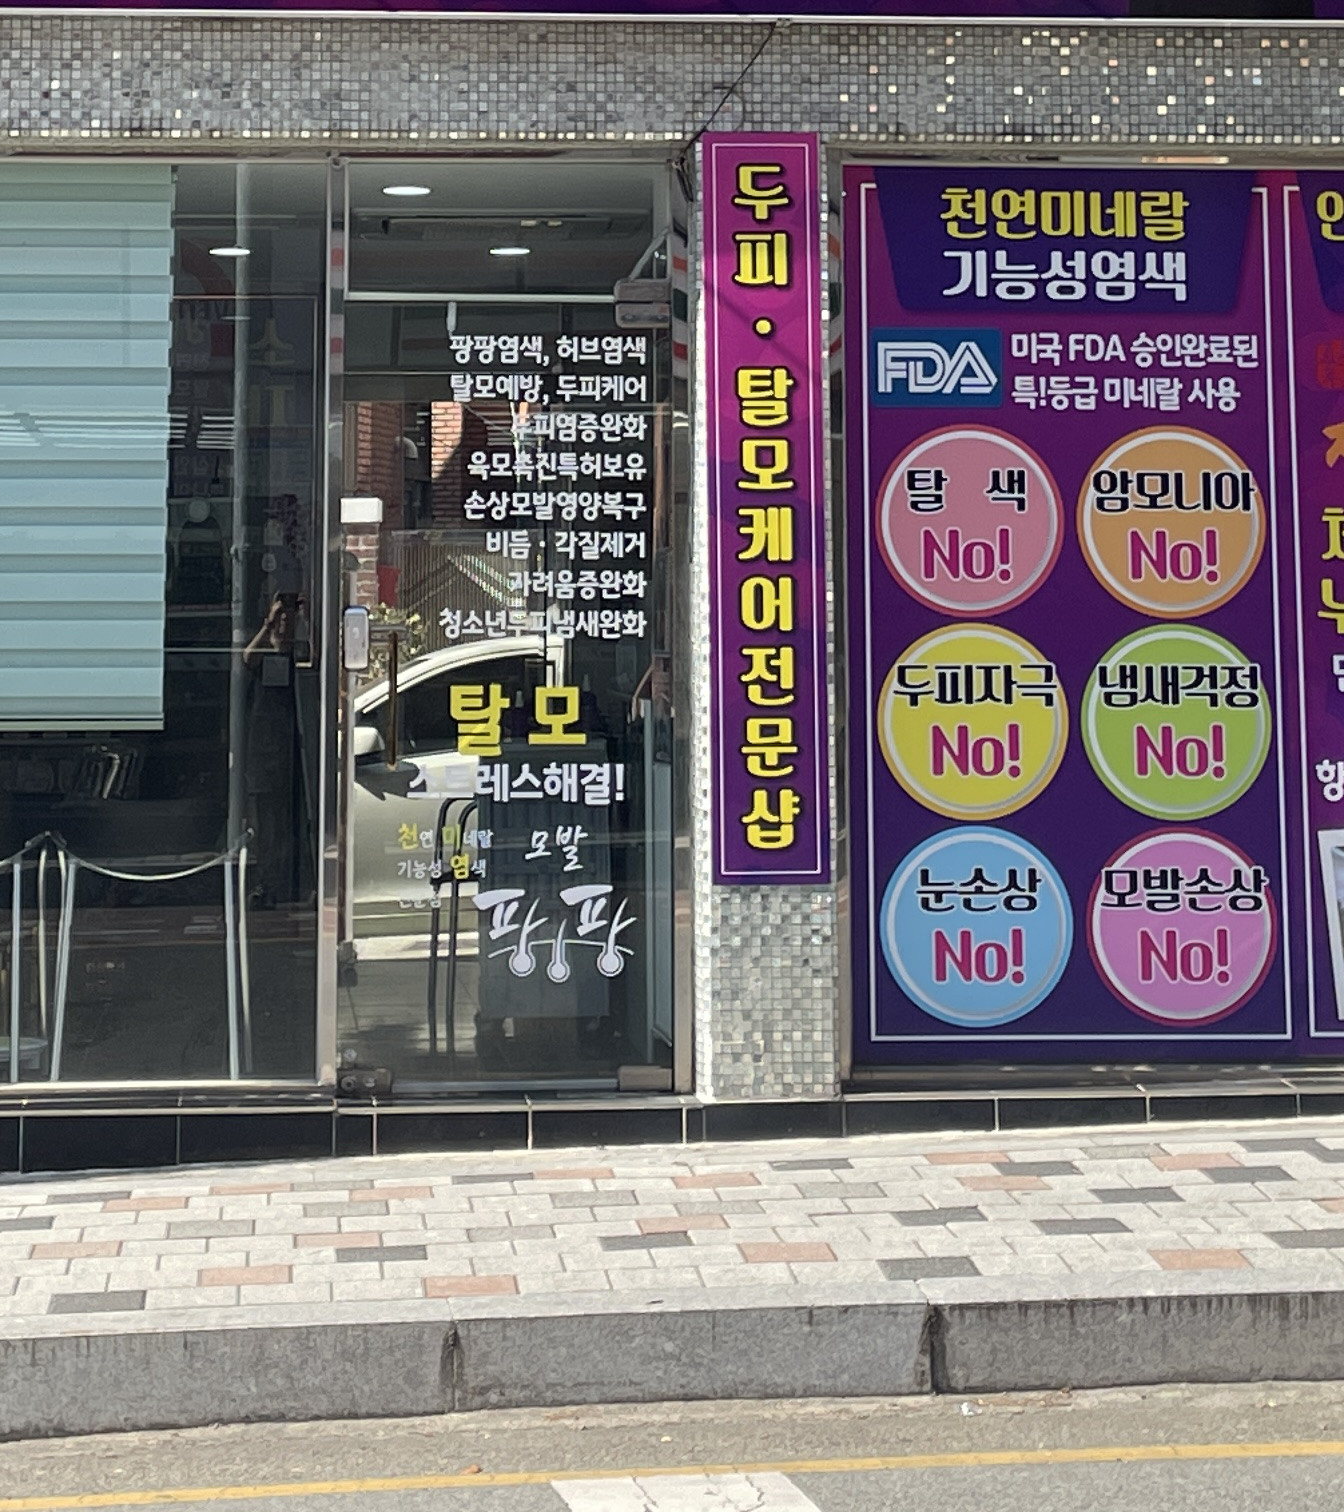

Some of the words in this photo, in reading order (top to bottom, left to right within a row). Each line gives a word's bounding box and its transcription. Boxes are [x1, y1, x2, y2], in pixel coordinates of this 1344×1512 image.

[940, 187, 1190, 242] 천연미네랄
[941, 249, 1188, 302] 기능성염색
[449, 335, 551, 366] 팡팡염색,
[556, 335, 647, 365] 허브염색
[877, 341, 998, 394] FDA
[1011, 334, 1062, 365] 미국
[1069, 335, 1126, 363] FDA
[1130, 332, 1259, 367] 승인완료된
[449, 374, 550, 404] 탈모예방,
[556, 375, 647, 402] 두피케어
[1103, 378, 1182, 411] 미네랄
[1188, 378, 1241, 411] 사용
[511, 413, 647, 443] 두피염증완화
[467, 451, 647, 481] 육모촉진특허보유
[463, 490, 647, 521] 손상모발영양복구
[1093, 470, 1256, 513] 암모니아
[485, 530, 531, 560] 비듬
[554, 531, 646, 560] 각질제거
[921, 528, 1012, 582] No!
[1127, 529, 1219, 584] No!
[508, 570, 647, 600] 가려움증완화
[439, 608, 647, 639] 청소년두피냄새완화
[893, 664, 1058, 707] 두피자극
[1097, 665, 1260, 709] 냄새걱정
[931, 724, 1022, 778] No!
[1135, 725, 1226, 779] No!
[397, 859, 443, 880] 기능성
[450, 853, 487, 880] 염색
[916, 867, 1042, 912] 눈손상
[1100, 867, 1269, 912] 모발손상
[933, 928, 1025, 984] No!
[1138, 928, 1230, 984] No!
